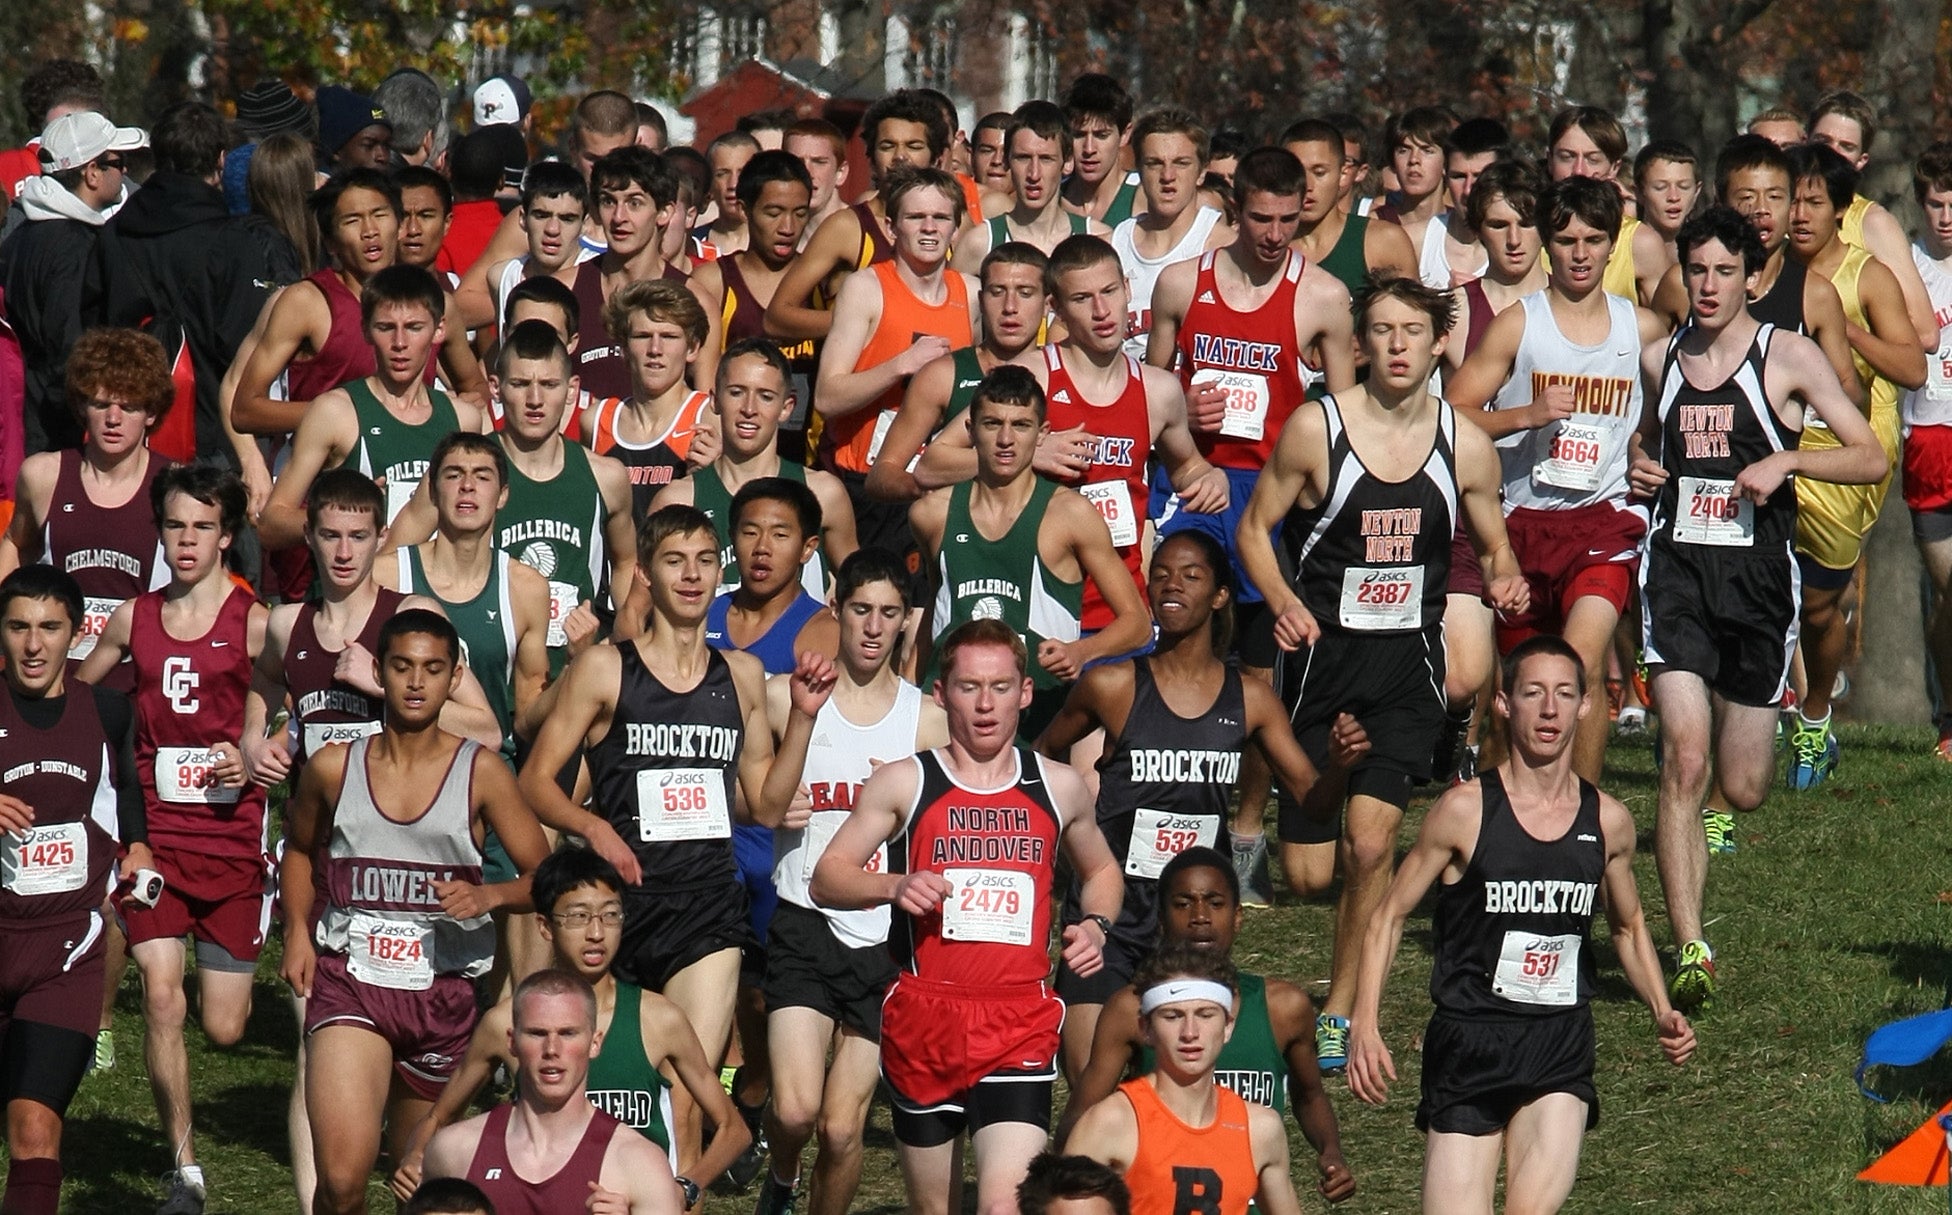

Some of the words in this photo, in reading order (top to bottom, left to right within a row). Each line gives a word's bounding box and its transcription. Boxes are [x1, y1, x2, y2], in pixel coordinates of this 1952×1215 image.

[1193, 333, 1281, 371] NATICK
[1225, 376, 1254, 388] asics
[1679, 404, 1735, 432] NEWTON
[1568, 428, 1597, 440] asics
[1684, 432, 1731, 459] NORTH
[1548, 437, 1600, 465] 3664
[1690, 495, 1741, 519] 2405
[501, 519, 581, 548] BILLERICA
[1361, 508, 1422, 535] NEWTON
[1365, 536, 1415, 562] NORTH
[65, 549, 141, 578] CHELMSFORD
[1379, 571, 1408, 582] asics
[957, 579, 1022, 602] BILLERICA
[1357, 582, 1412, 605] 2387
[298, 690, 368, 718] CHELMSFORD
[334, 729, 362, 739] asics
[625, 723, 739, 762] BROCKTON
[178, 765, 219, 789] 935
[674, 772, 705, 785] asics
[1130, 749, 1242, 784] BROCKTON
[662, 786, 707, 812] 536
[948, 806, 1031, 832] NORTH
[1171, 818, 1202, 830] asics
[36, 829, 67, 842] asics
[1154, 828, 1198, 854] 532
[18, 841, 75, 868] 1425
[931, 836, 1045, 865] ANDOVER
[981, 875, 1015, 888] asics
[960, 887, 1020, 915] 2479
[1485, 880, 1599, 917] BROCKTON
[385, 925, 417, 937] asics
[367, 935, 422, 962] 1824
[1522, 952, 1561, 977] 531
